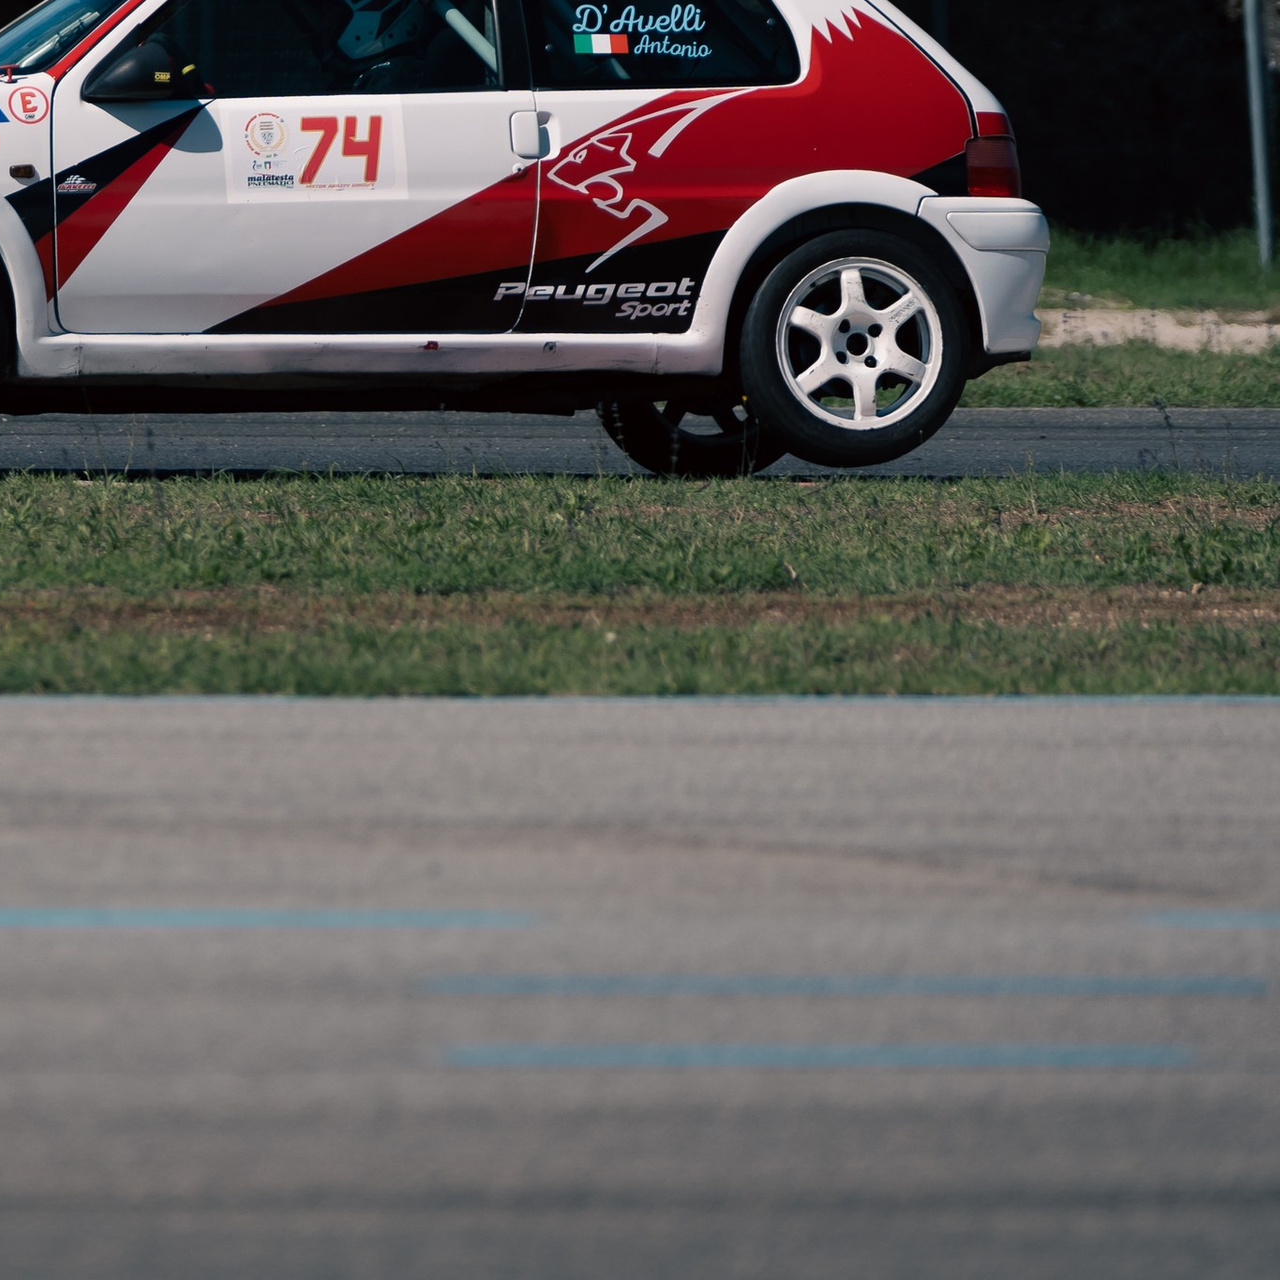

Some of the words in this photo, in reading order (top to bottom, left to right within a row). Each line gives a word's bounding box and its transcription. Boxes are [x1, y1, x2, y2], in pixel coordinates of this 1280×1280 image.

[634, 34, 712, 58] Antonio
[20, 91, 39, 114] E
[299, 114, 382, 185] 74
[247, 173, 294, 182] malatesta
[493, 276, 695, 305] Peugeot
[615, 298, 692, 320] Sport
